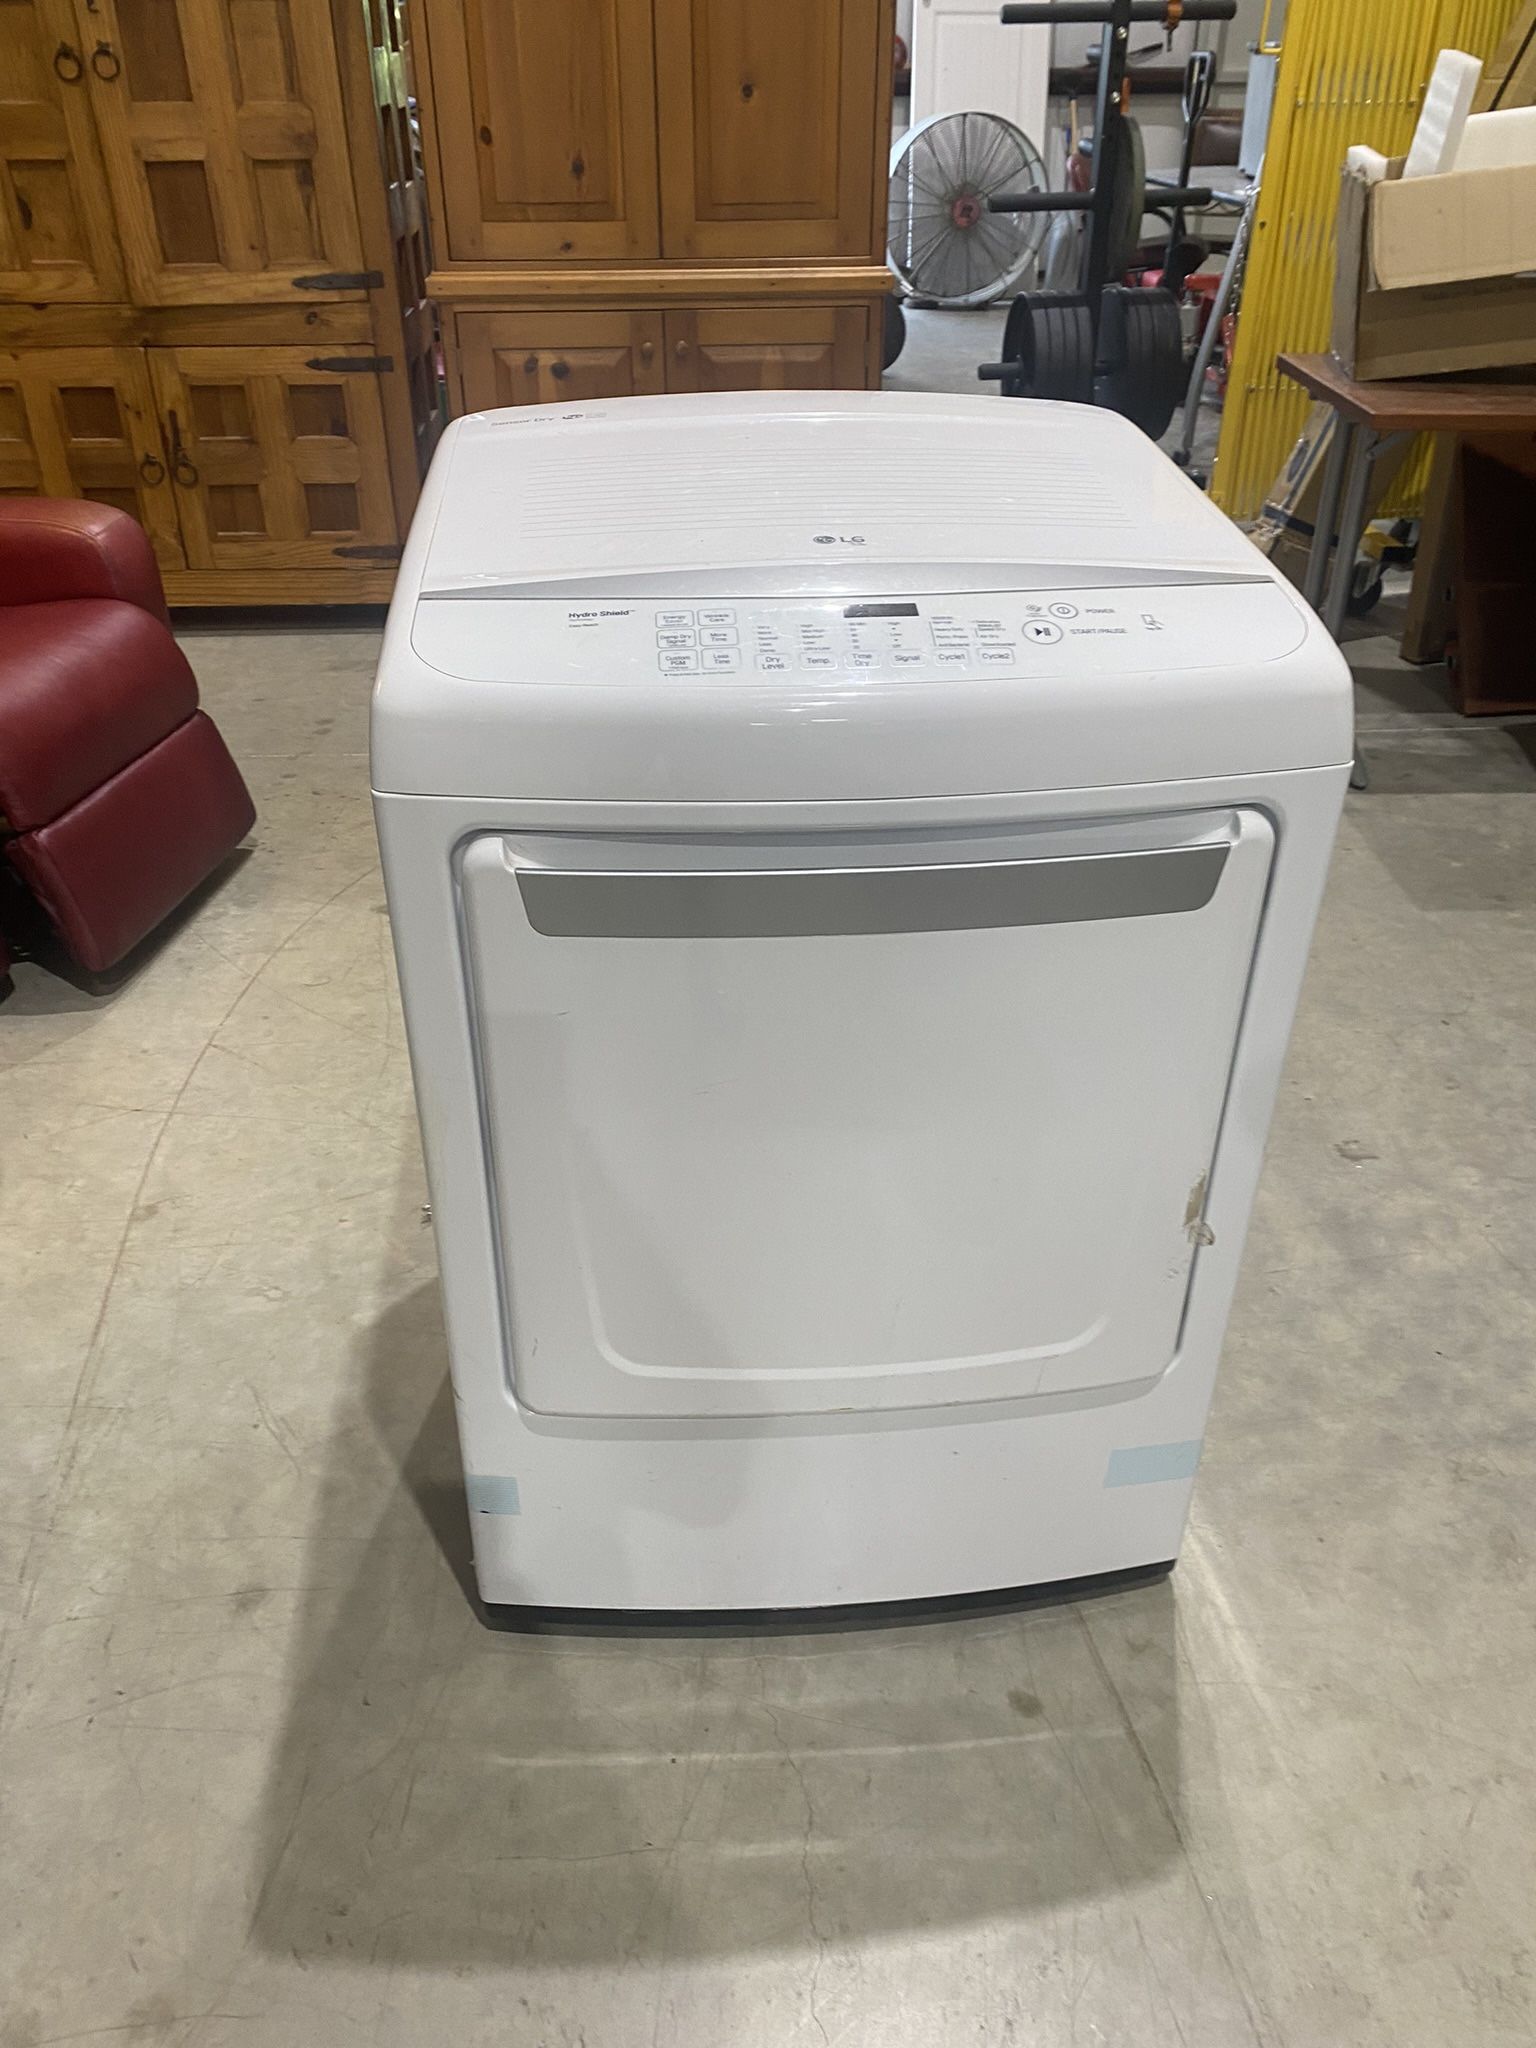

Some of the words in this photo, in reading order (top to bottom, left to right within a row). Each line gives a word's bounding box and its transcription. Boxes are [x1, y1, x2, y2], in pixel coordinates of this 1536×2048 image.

[938, 653, 966, 661] Cycle1
[982, 653, 1010, 661] Cycle2
[854, 659, 870, 667] Dry
